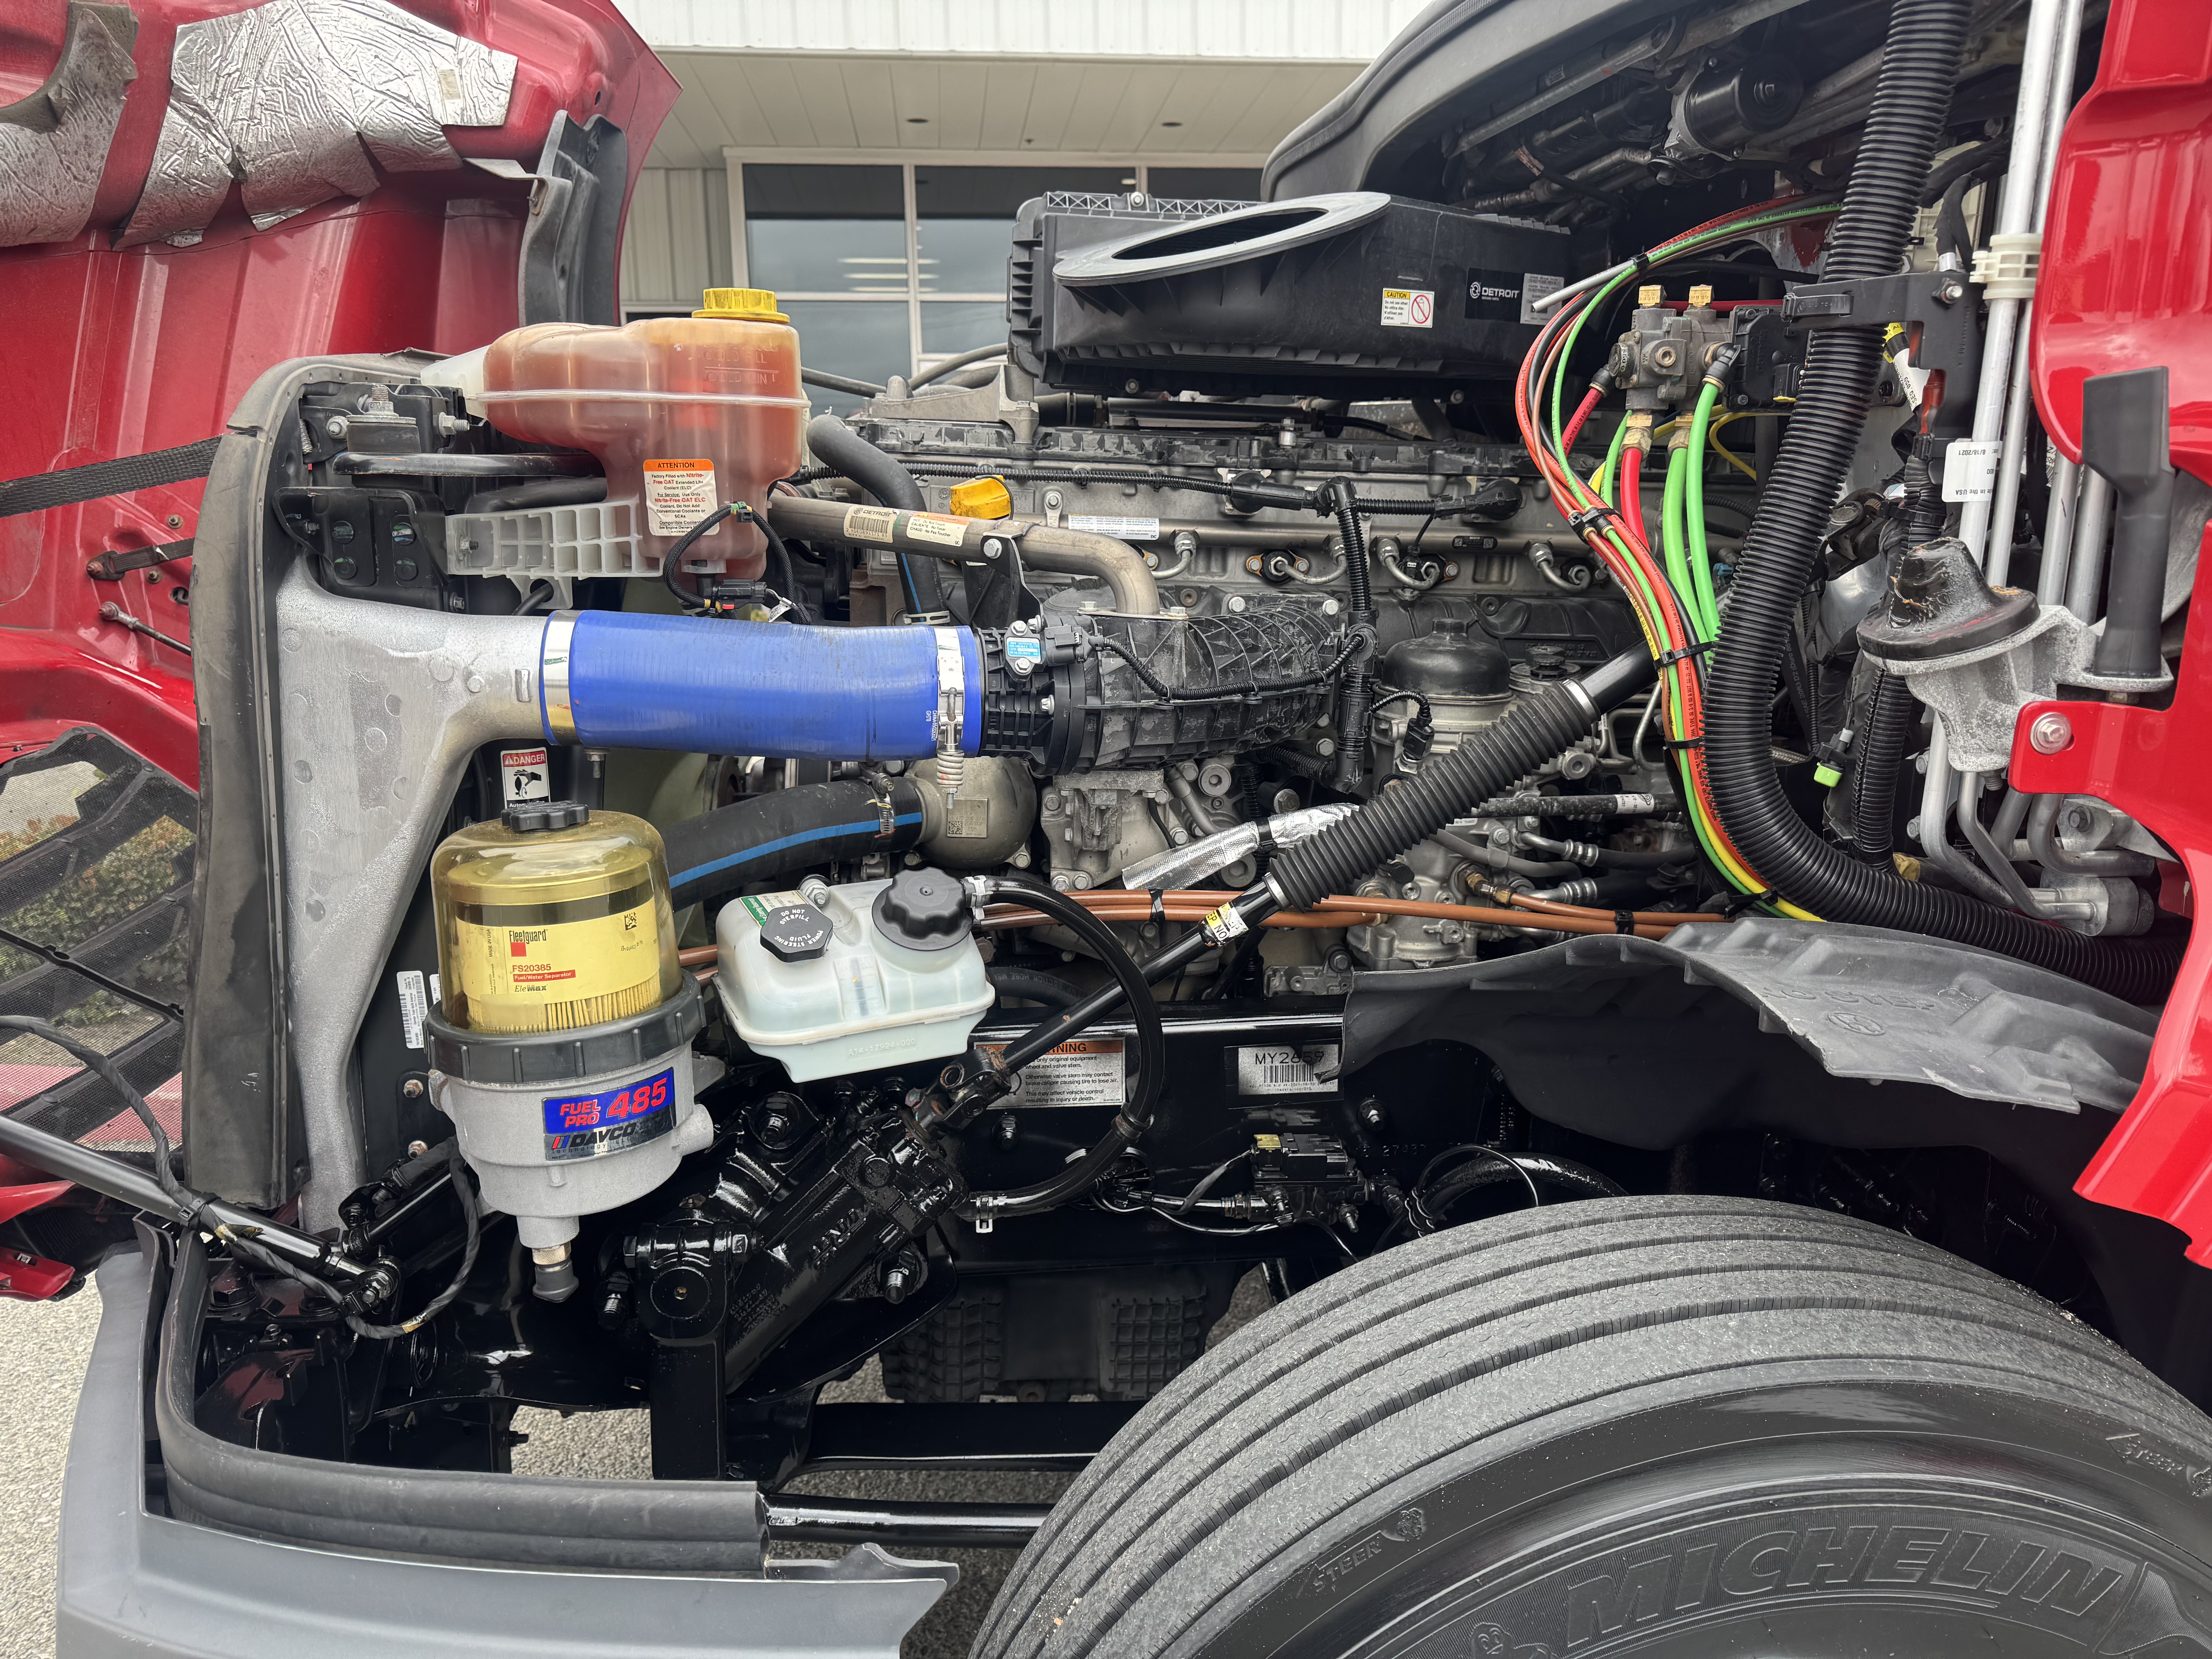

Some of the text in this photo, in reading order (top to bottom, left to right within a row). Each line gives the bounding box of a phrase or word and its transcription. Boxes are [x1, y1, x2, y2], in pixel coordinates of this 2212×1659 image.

[1482, 287, 1519, 298] DETROIT
[704, 350, 739, 361] COLD
[707, 372, 741, 382] COLD
[1793, 672, 1800, 681] D2
[514, 754, 545, 764] DANGER
[780, 914, 809, 925] OVERFILL
[509, 929, 546, 944] Fleetguard
[774, 930, 824, 947] POWER STEERING
[789, 934, 811, 942] FLUID
[512, 964, 551, 972] FS20385
[1010, 972, 1030, 981] HOSE
[1255, 1051, 1324, 1065] MY2659
[560, 1077, 667, 1118] FUEL 485
[565, 1112, 599, 1128] PRO
[570, 1122, 637, 1148] DAVCO
[1313, 1540, 1382, 1592] STEER
[1567, 1526, 2124, 1647] MICHELIN
